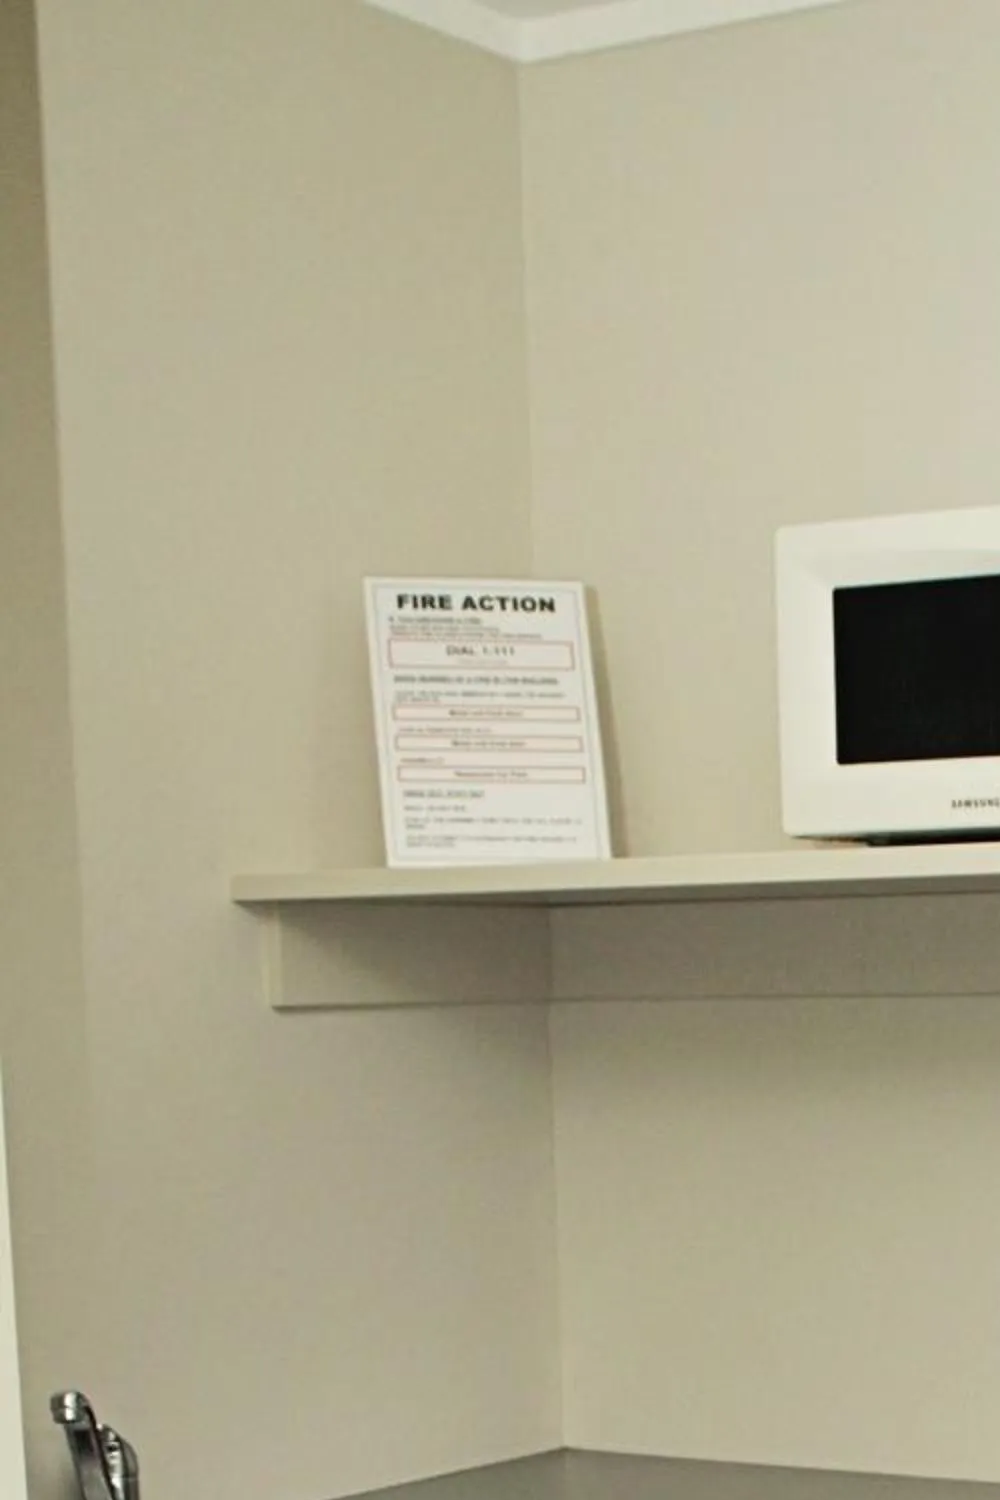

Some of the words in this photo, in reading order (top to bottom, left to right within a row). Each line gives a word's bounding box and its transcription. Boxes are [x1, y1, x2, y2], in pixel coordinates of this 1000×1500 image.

[396, 594, 452, 611] FIRE
[461, 595, 556, 613] ACTION
[446, 645, 475, 656] DIAL
[951, 796, 1000, 809] SAMSUNG
